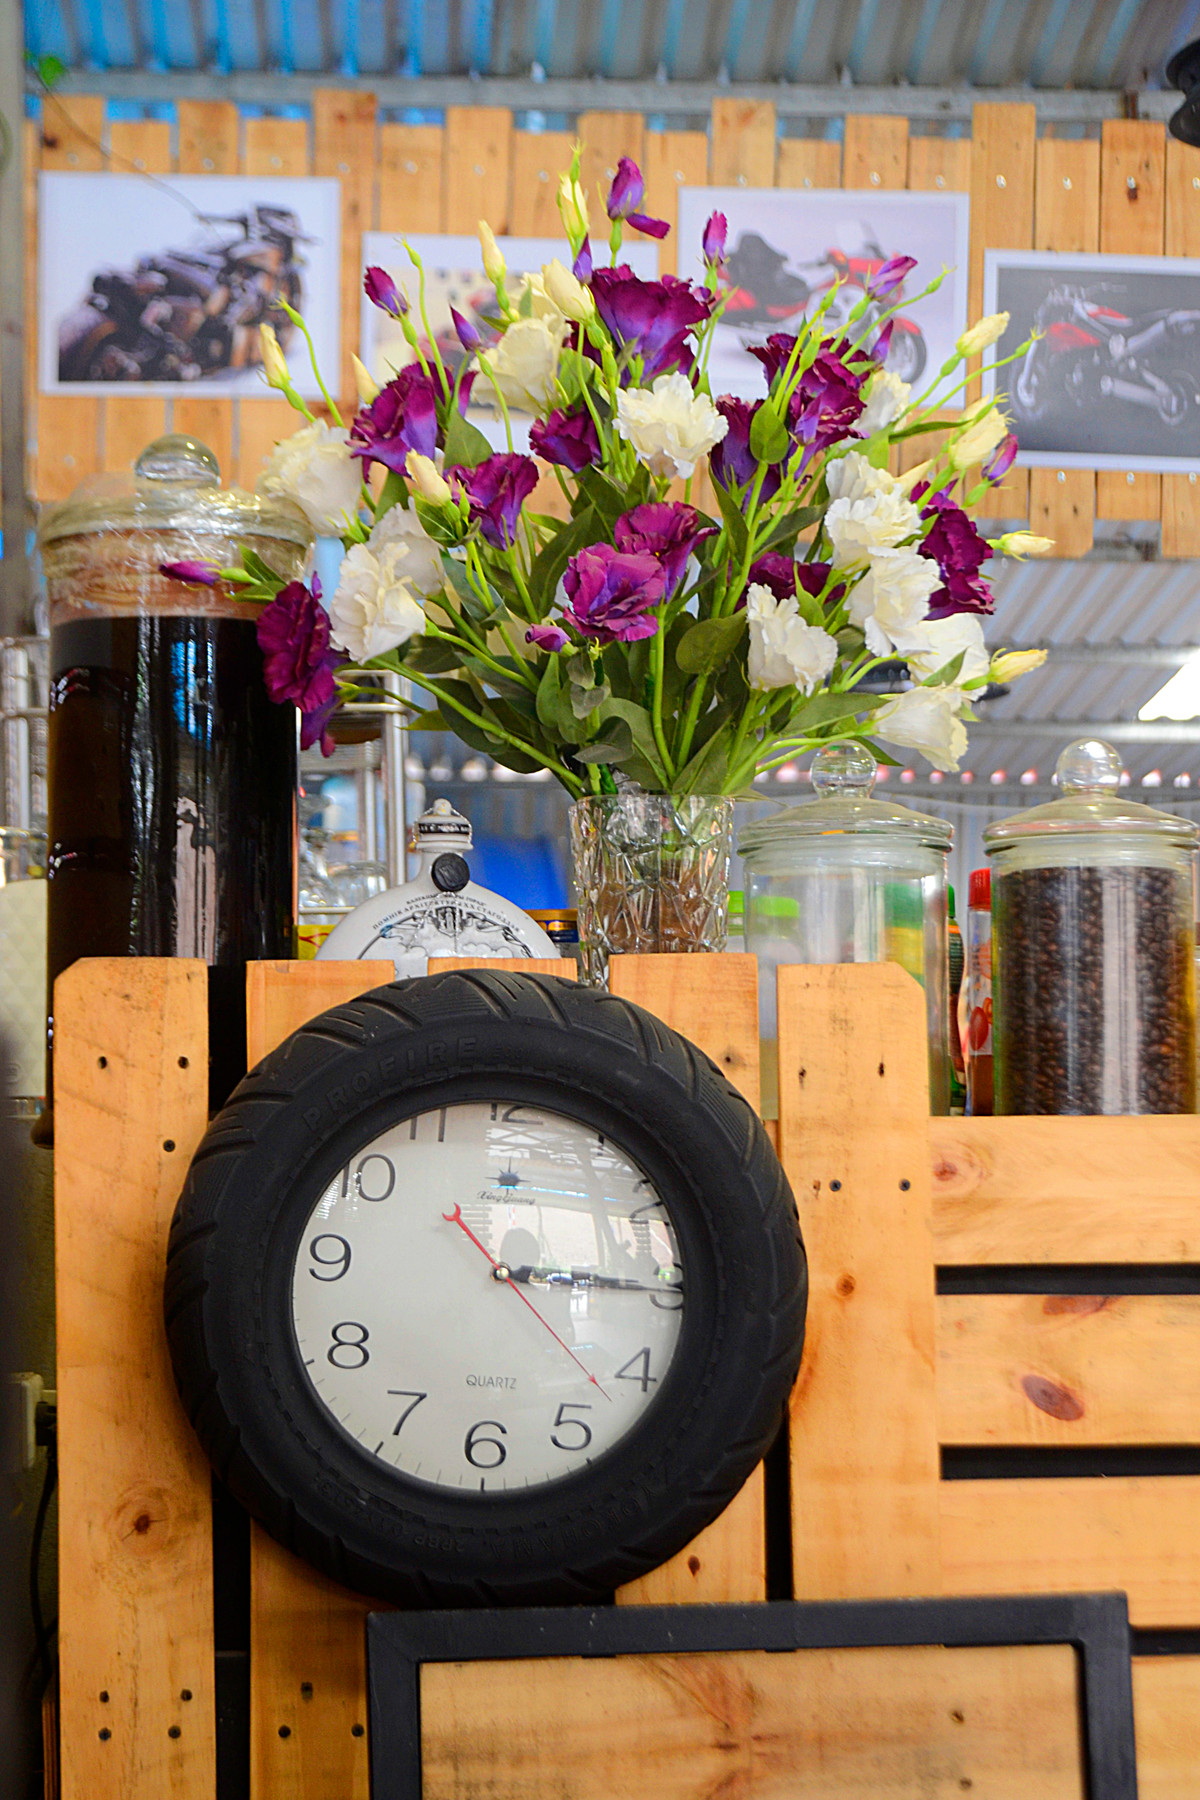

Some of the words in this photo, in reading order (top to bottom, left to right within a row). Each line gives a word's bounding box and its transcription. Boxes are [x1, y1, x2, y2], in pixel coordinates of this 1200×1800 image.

[303, 1037, 477, 1131] PROFIRE
[341, 1153, 396, 1202] 10
[309, 1233, 352, 1281] 9
[327, 1321, 370, 1369] 8
[465, 1374, 517, 1390] QUARTZ
[614, 1347, 657, 1392] 4
[387, 1389, 427, 1436] 7
[550, 1403, 592, 1450] 5
[464, 1420, 507, 1468] 6
